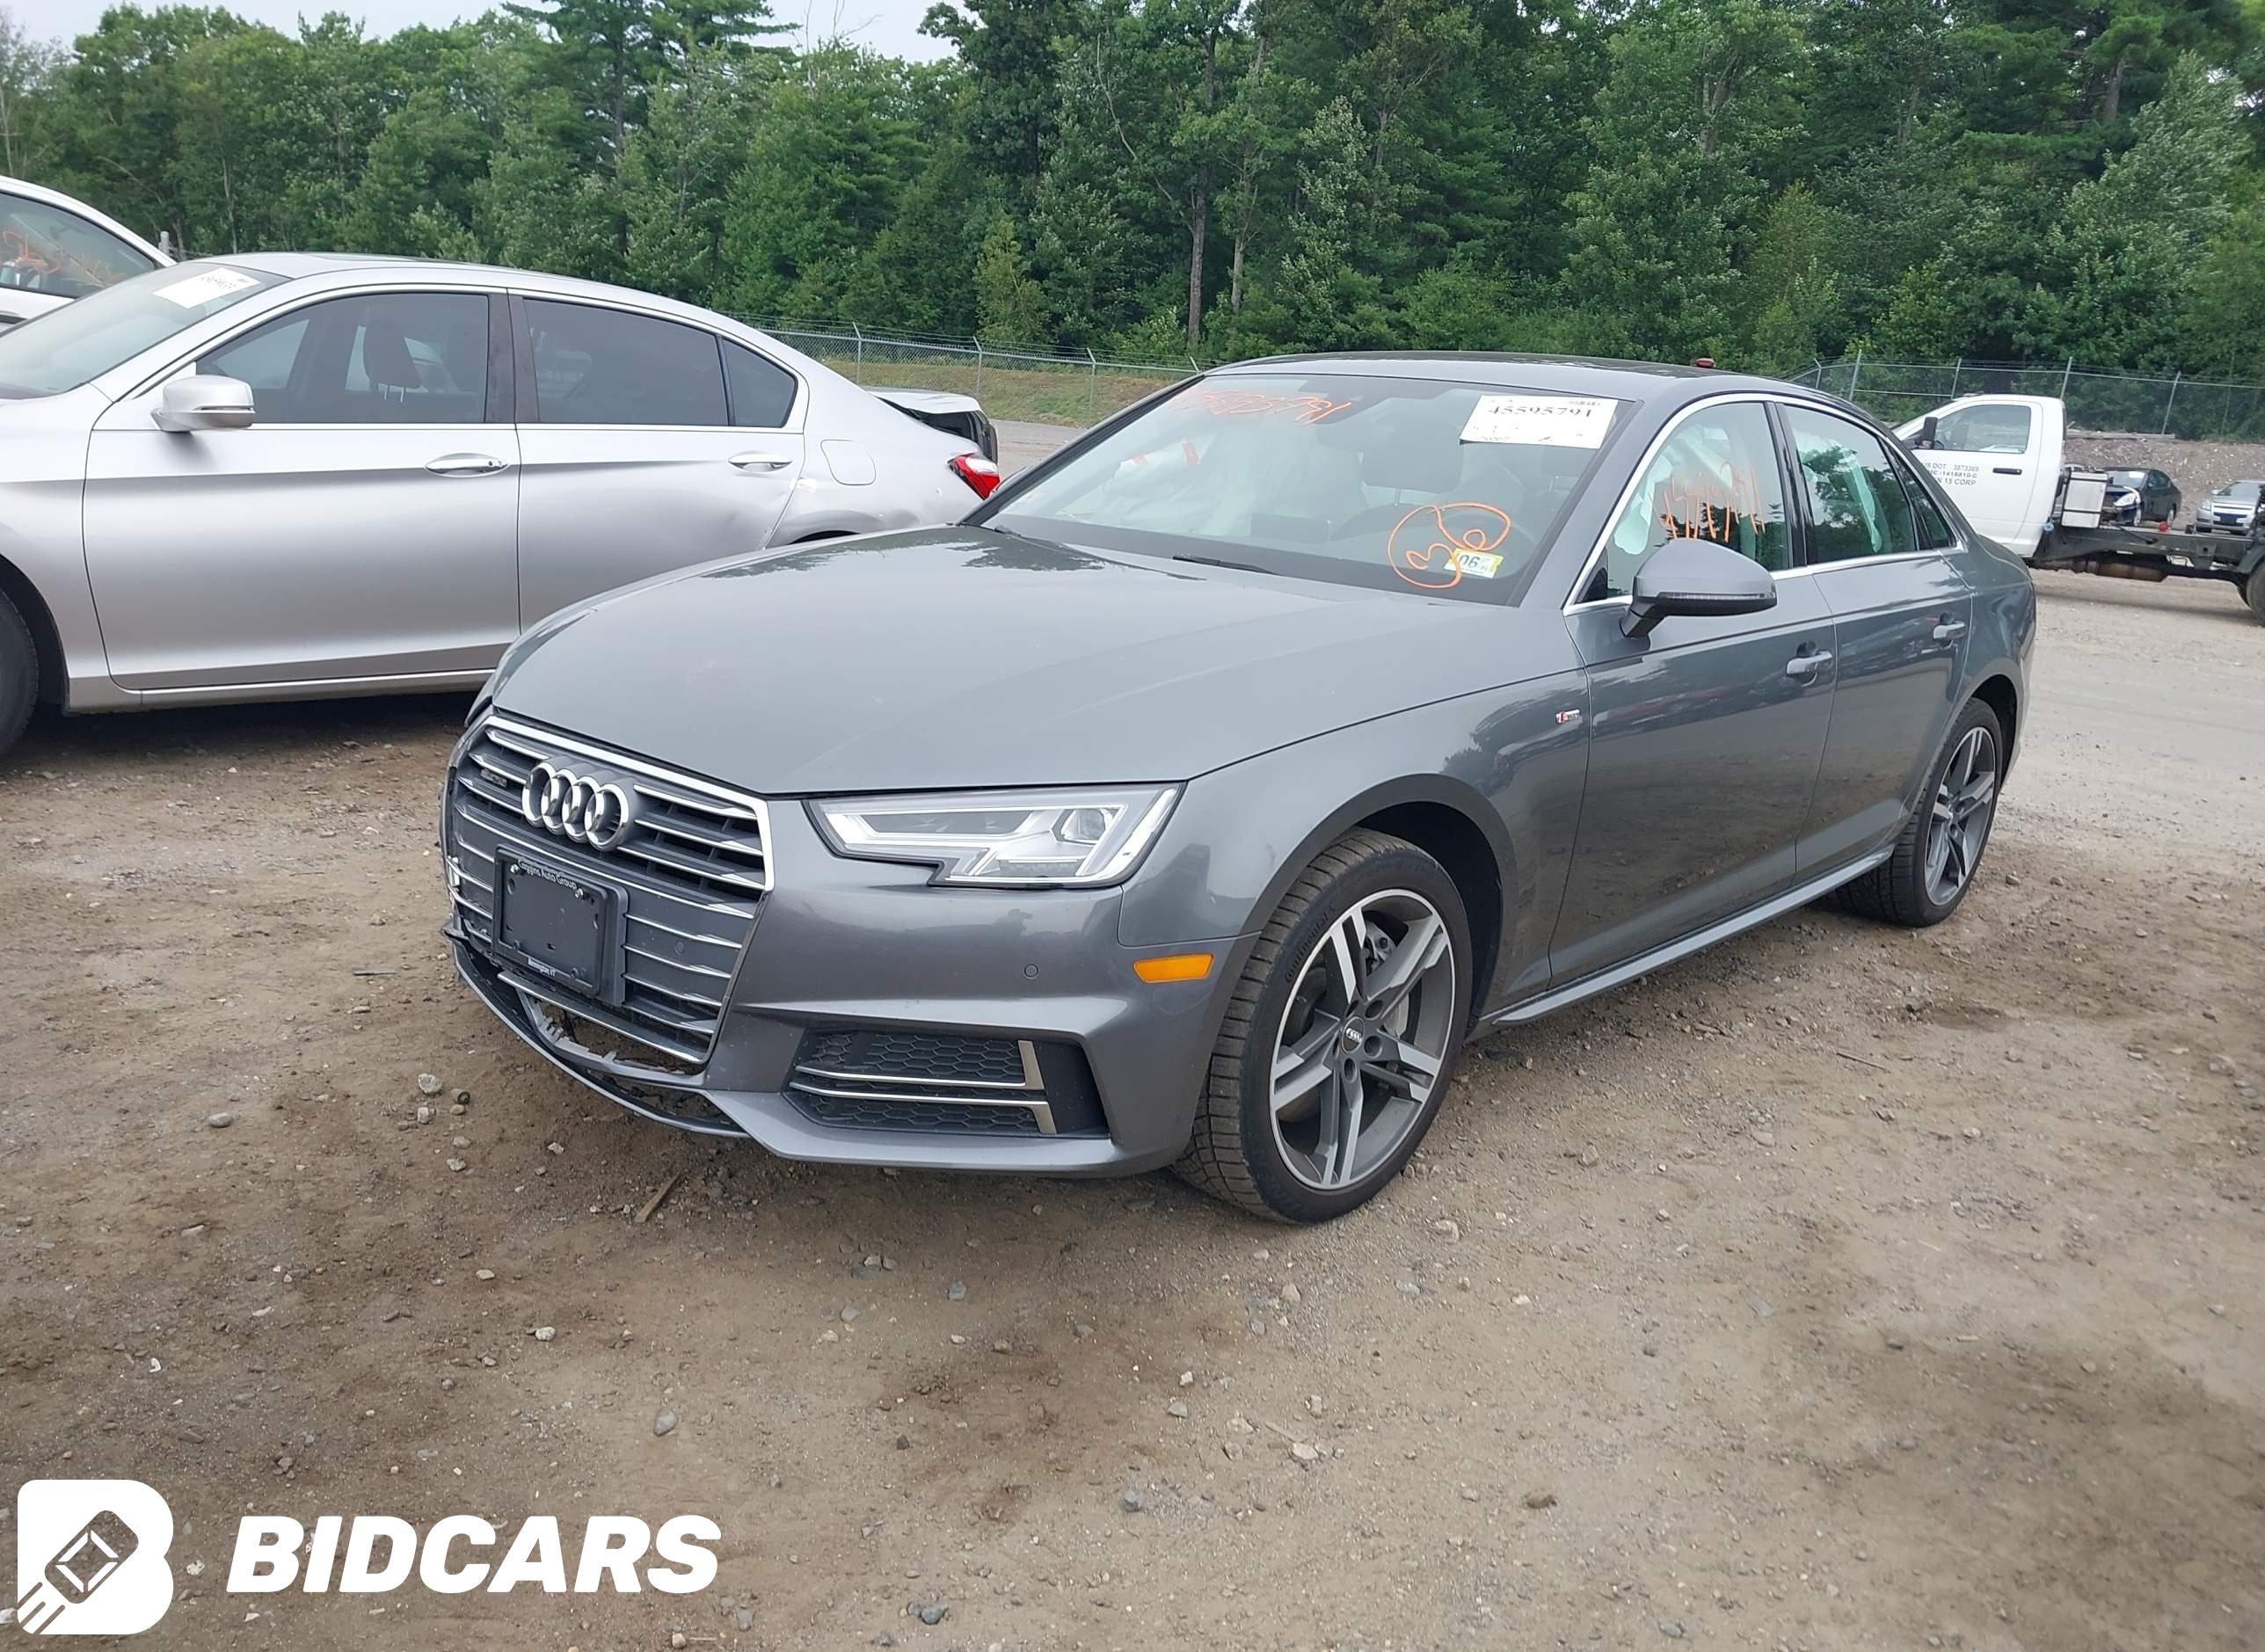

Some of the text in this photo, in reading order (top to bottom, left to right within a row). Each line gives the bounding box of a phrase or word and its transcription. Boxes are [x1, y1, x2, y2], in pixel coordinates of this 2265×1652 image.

[1488, 405, 1593, 418] 45595791
[1459, 554, 1481, 569] 06
[541, 868, 557, 883] Auto
[556, 872, 578, 891] Group
